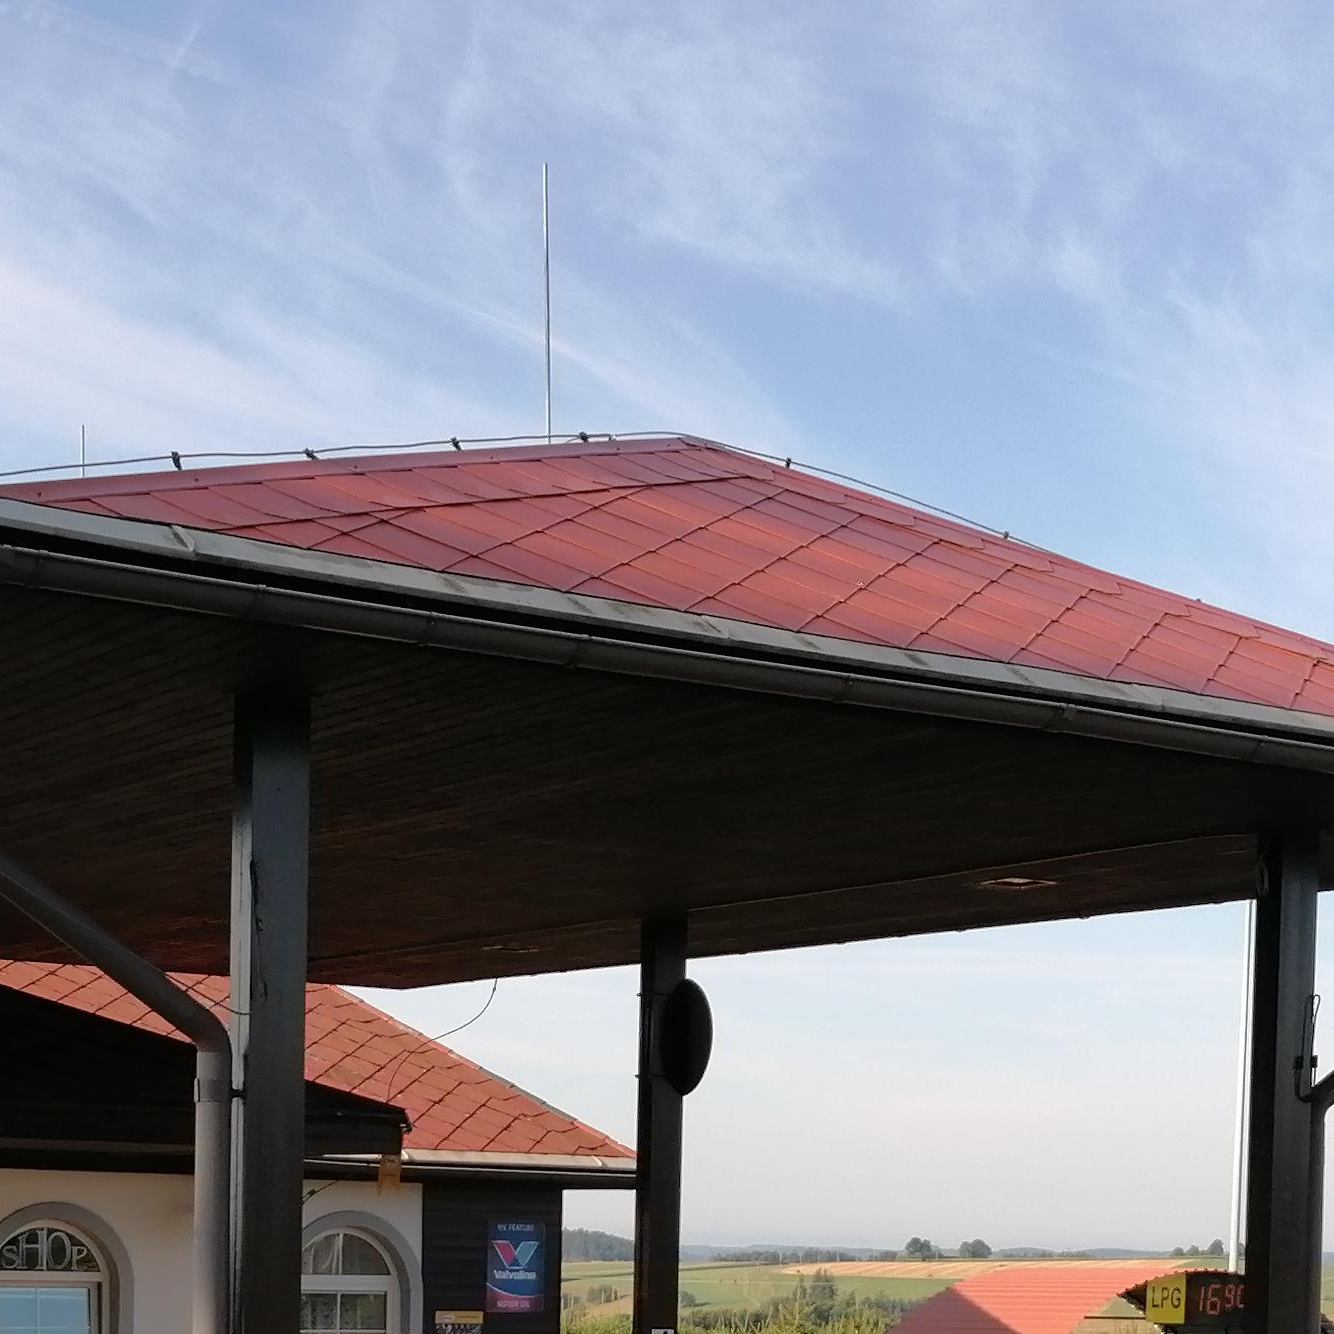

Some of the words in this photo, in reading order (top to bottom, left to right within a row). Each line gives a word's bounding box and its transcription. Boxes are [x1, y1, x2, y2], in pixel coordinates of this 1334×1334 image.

[2, 1230, 87, 1270] SHOP
[493, 1269, 536, 1280] Valvoline
[1151, 1286, 1181, 1309] LPG
